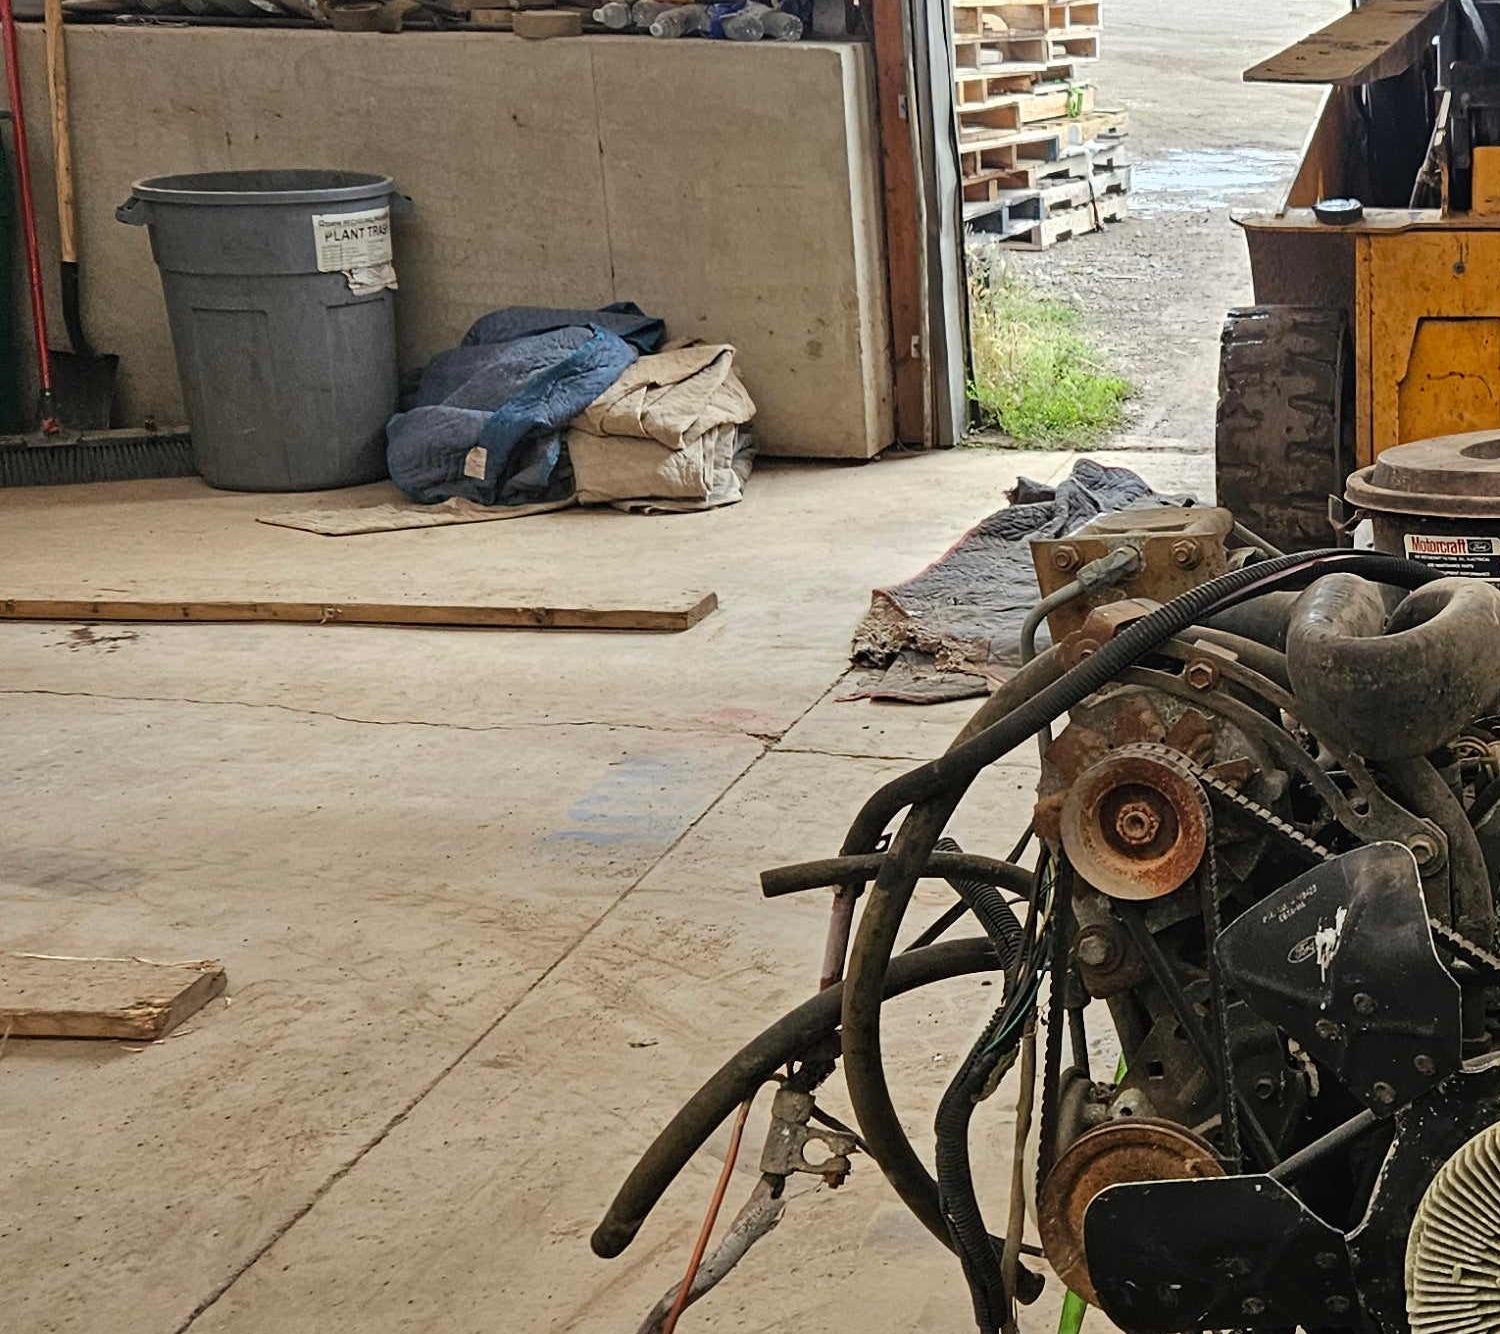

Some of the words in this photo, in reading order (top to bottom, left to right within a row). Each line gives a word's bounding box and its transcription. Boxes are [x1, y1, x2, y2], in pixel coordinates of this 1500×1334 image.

[324, 227, 365, 242] PLANT
[367, 224, 388, 238] TRAS
[1411, 536, 1467, 554] Motorcraft
